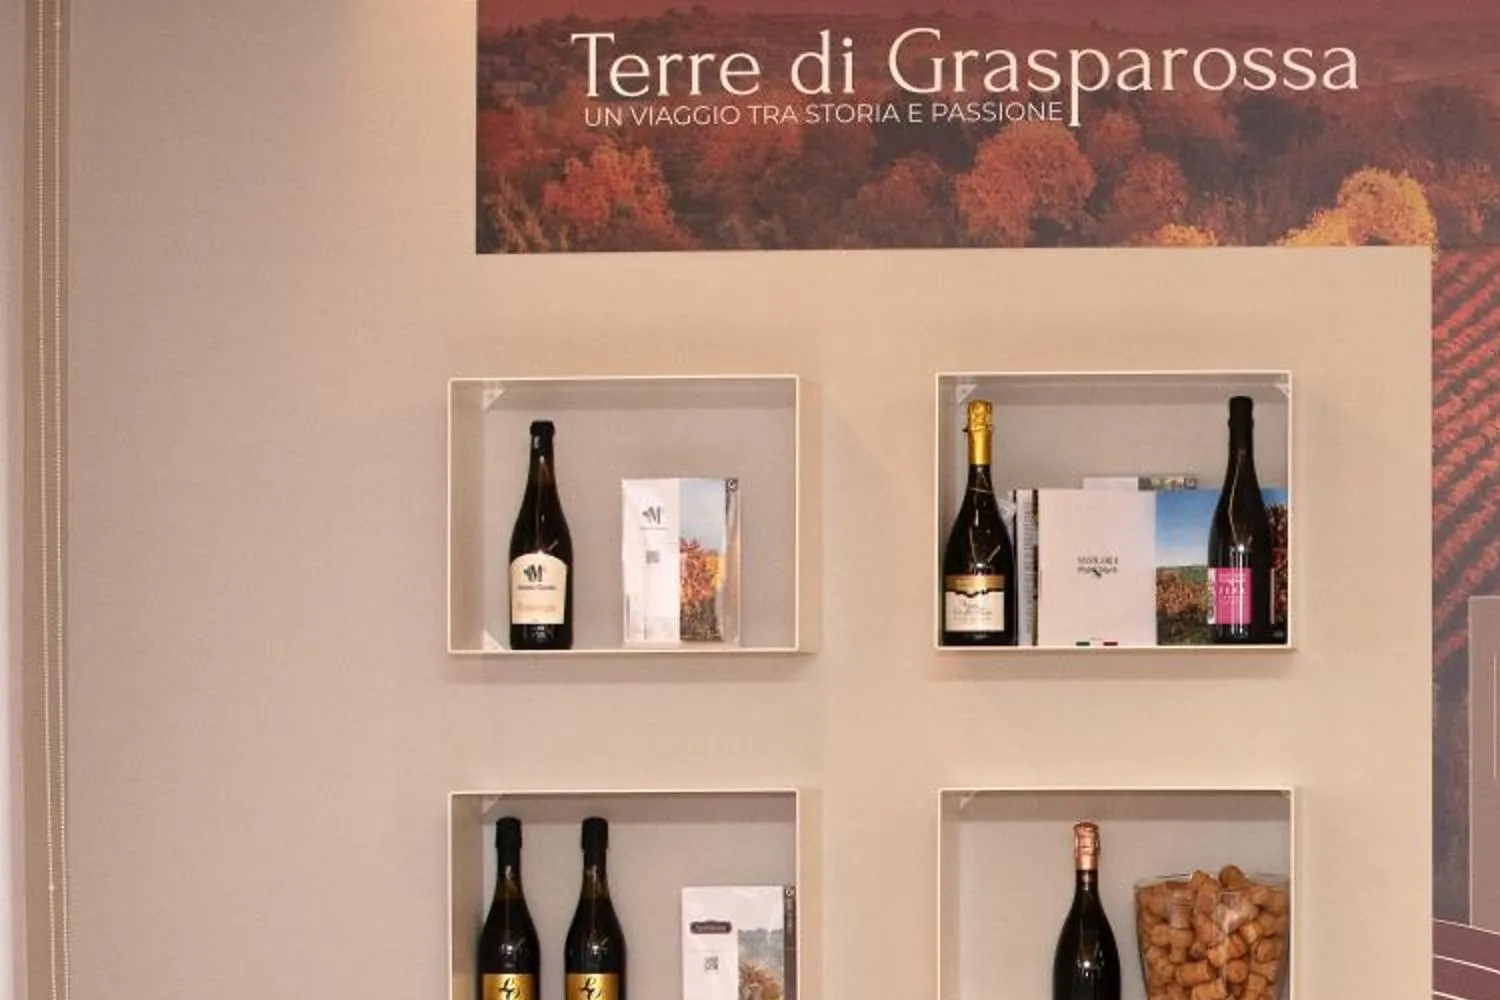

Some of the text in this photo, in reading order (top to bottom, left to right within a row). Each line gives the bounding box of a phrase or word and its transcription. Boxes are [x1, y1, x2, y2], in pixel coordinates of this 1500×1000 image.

[570, 27, 1359, 126] Terre di Grasparossa
[584, 101, 1064, 127] UN VIAGGIO TRA STORIA E PASSIONE
